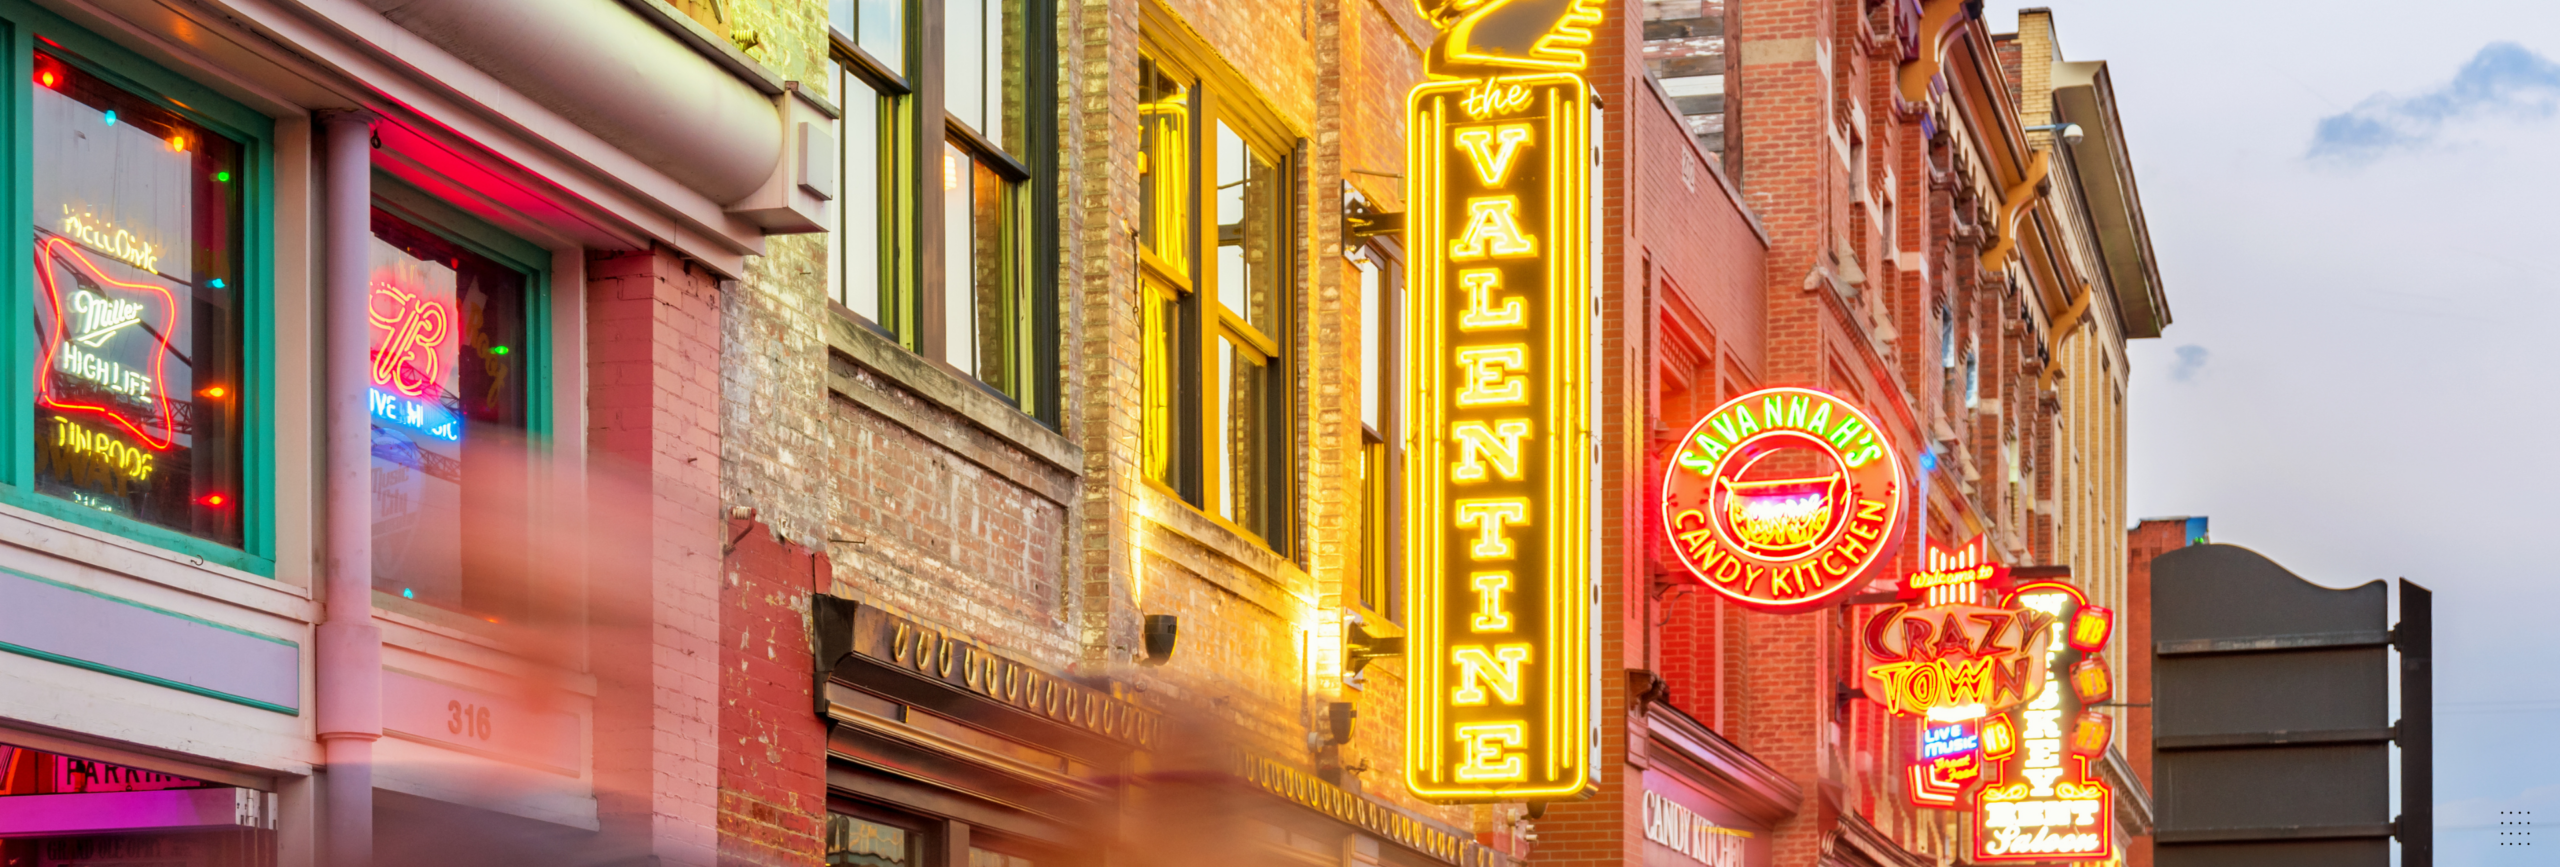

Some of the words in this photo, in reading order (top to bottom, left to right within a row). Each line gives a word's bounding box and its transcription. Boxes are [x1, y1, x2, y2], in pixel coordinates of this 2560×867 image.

[1460, 77, 1534, 120] the
[74, 290, 144, 334] Miller
[63, 341, 109, 385] HIGH
[110, 361, 152, 403] LIFE
[370, 387, 397, 420] IVE
[54, 415, 92, 455] TIN
[1449, 123, 1538, 783] VALENTINE
[1678, 395, 1883, 476] SAVANNAH'S
[1675, 508, 1764, 592] CANDY
[1772, 498, 1888, 596] KITCHEN
[1909, 568, 1976, 590] Welcome
[1976, 564, 1994, 581] to
[1862, 602, 2057, 662] CRAZY
[2075, 614, 2106, 645] WB
[1867, 655, 2033, 714] TOWN
[2077, 667, 2108, 698] WB
[447, 699, 492, 741] 316
[1924, 724, 1962, 744] LIVE
[1981, 721, 2011, 755] WB
[2075, 720, 2106, 750] WB
[1924, 734, 1978, 759] MUSIC
[66, 757, 188, 786] PARKIN
[1642, 789, 1691, 857] CANDY
[1986, 825, 2100, 855] Saloon
